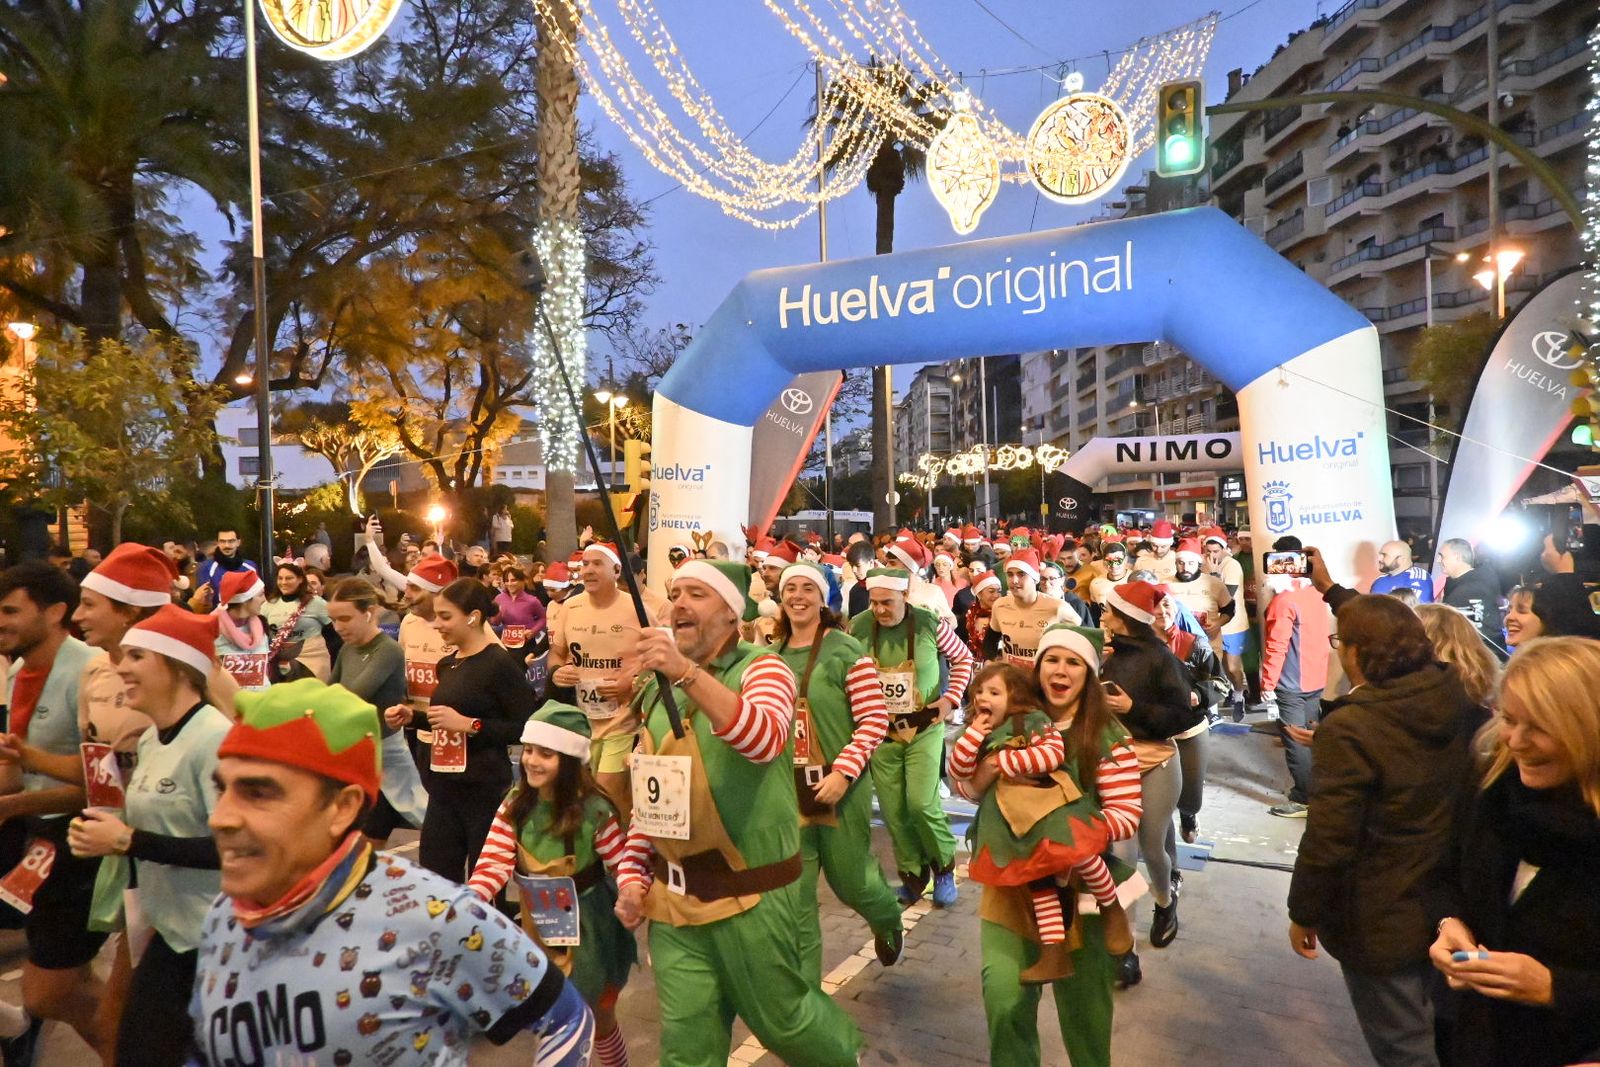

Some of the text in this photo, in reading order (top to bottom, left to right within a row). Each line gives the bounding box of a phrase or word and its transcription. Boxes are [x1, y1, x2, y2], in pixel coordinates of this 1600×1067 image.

[779, 240, 1132, 329] Huelva original
[1503, 358, 1567, 400] HUELVA
[765, 409, 804, 437] HUELVA
[1116, 438, 1232, 462] NIMO
[1258, 434, 1357, 465] Huelva
[661, 519, 701, 530] HUELVA
[1300, 509, 1363, 525] HUELVA
[225, 660, 263, 674] 2221
[408, 667, 439, 685] 193
[647, 776, 660, 804] 9
[210, 984, 326, 1067] COMO
